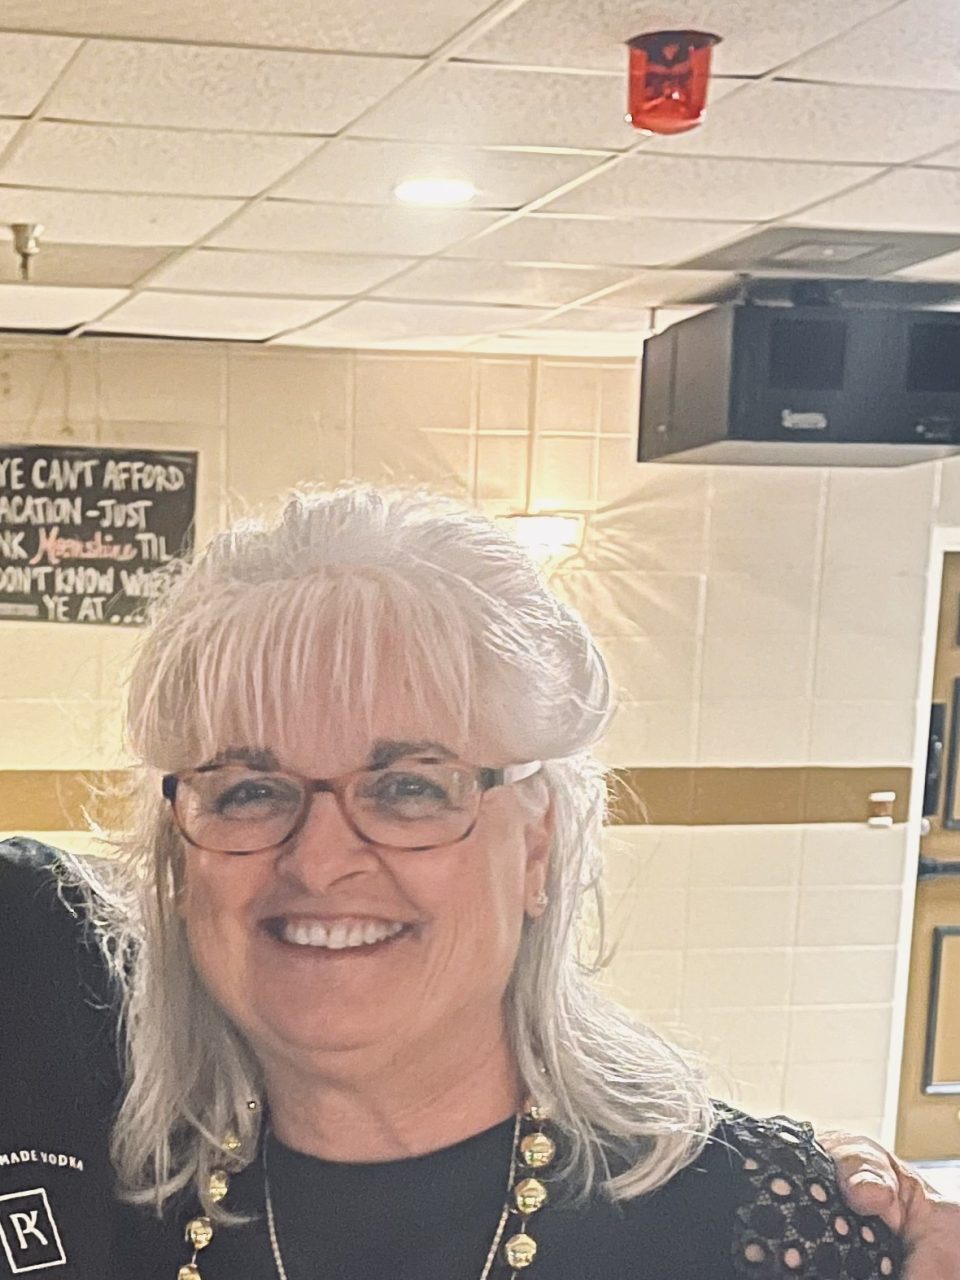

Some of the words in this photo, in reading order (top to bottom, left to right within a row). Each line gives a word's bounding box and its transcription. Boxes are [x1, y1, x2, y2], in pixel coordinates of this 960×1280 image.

[102, 459, 185, 493] AFFORD
[54, 565, 115, 596] KNOW
[42, 593, 71, 623] YE
[40, 1150, 84, 1172] VODKA
